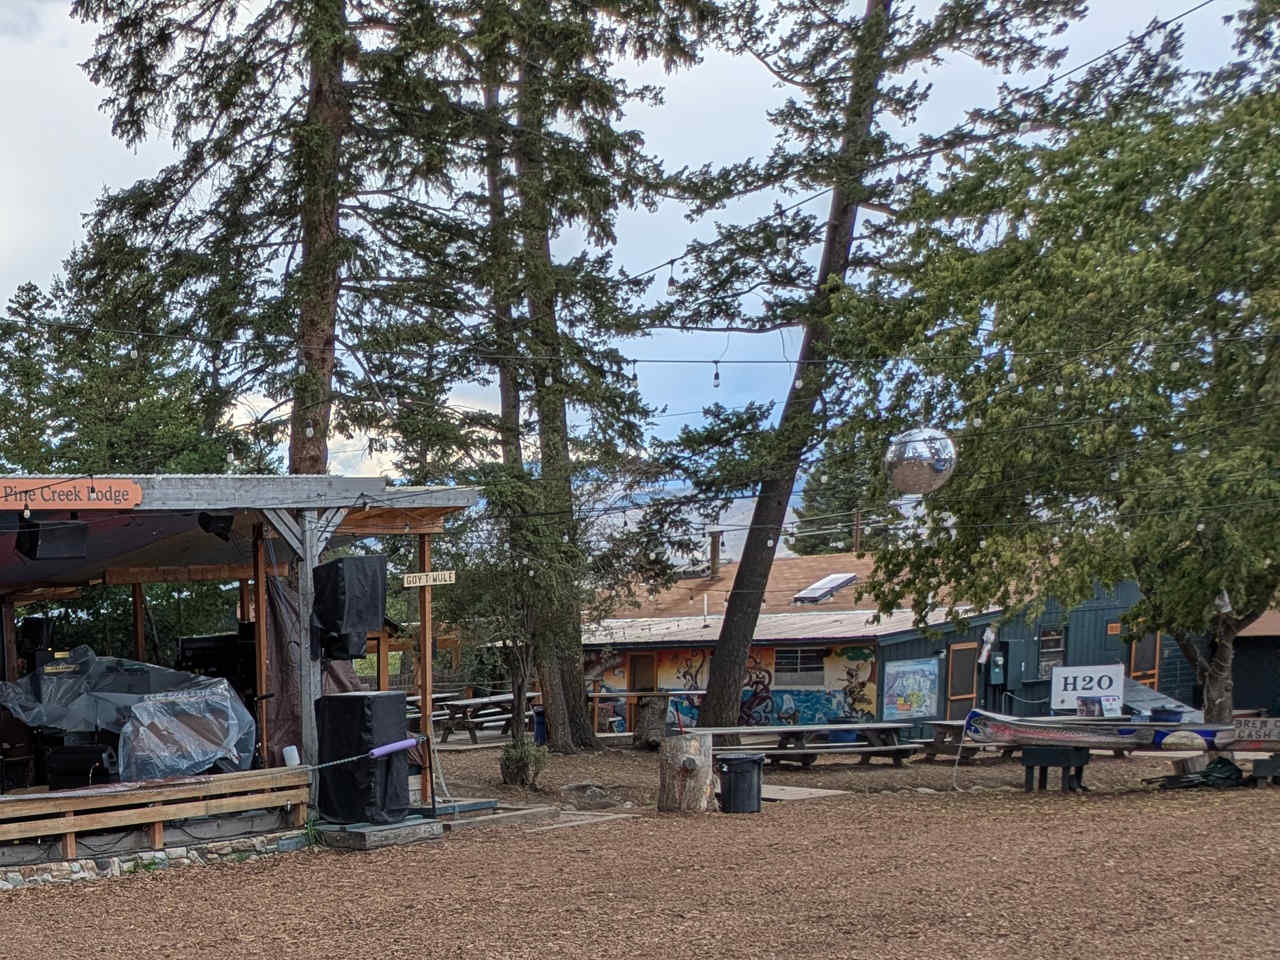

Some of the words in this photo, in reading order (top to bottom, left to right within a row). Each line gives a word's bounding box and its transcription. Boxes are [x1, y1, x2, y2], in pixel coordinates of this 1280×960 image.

[4, 486, 36, 503] Pine
[40, 486, 81, 503] Creek
[88, 486, 129, 505] Lodge
